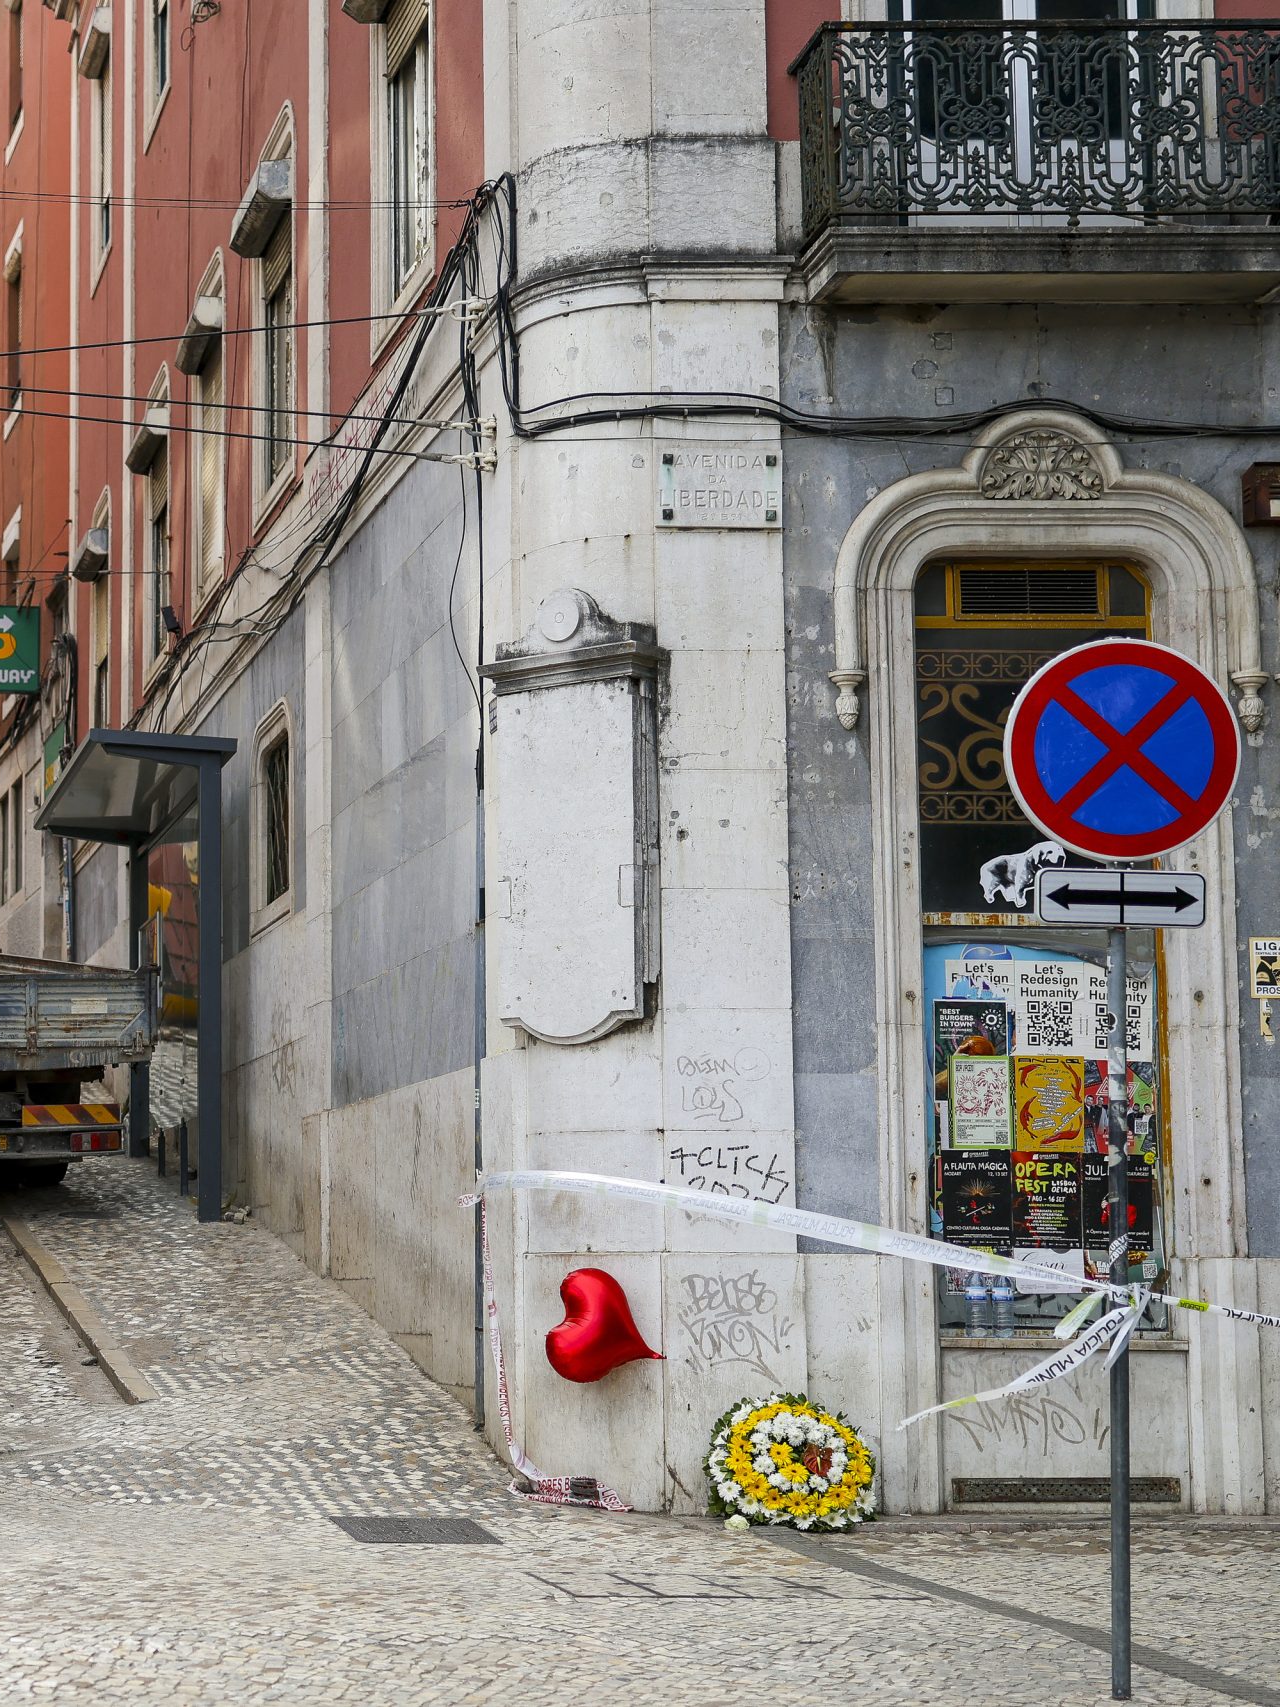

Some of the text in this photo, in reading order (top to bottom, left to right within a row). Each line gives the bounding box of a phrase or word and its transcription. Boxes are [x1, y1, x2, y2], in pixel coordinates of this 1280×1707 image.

[673, 454, 764, 468] AVENIDA
[708, 474, 727, 484] DA
[658, 489, 778, 509] LIBERDADE
[965, 962, 994, 973] Let's
[1034, 964, 1064, 975] Let's
[1020, 974, 1078, 987] Redesign
[1020, 986, 1079, 1000] Humanity
[1089, 989, 1148, 1004] Hunity
[939, 1014, 974, 1022] BURGERS
[943, 1160, 1009, 1171] A FLAUTA MÁGICA
[1014, 1161, 1078, 1178] OPERA
[1084, 1164, 1110, 1176] JULI
[1015, 1179, 1050, 1194] FEST
[1074, 1311, 1126, 1357] POLÍCIA
